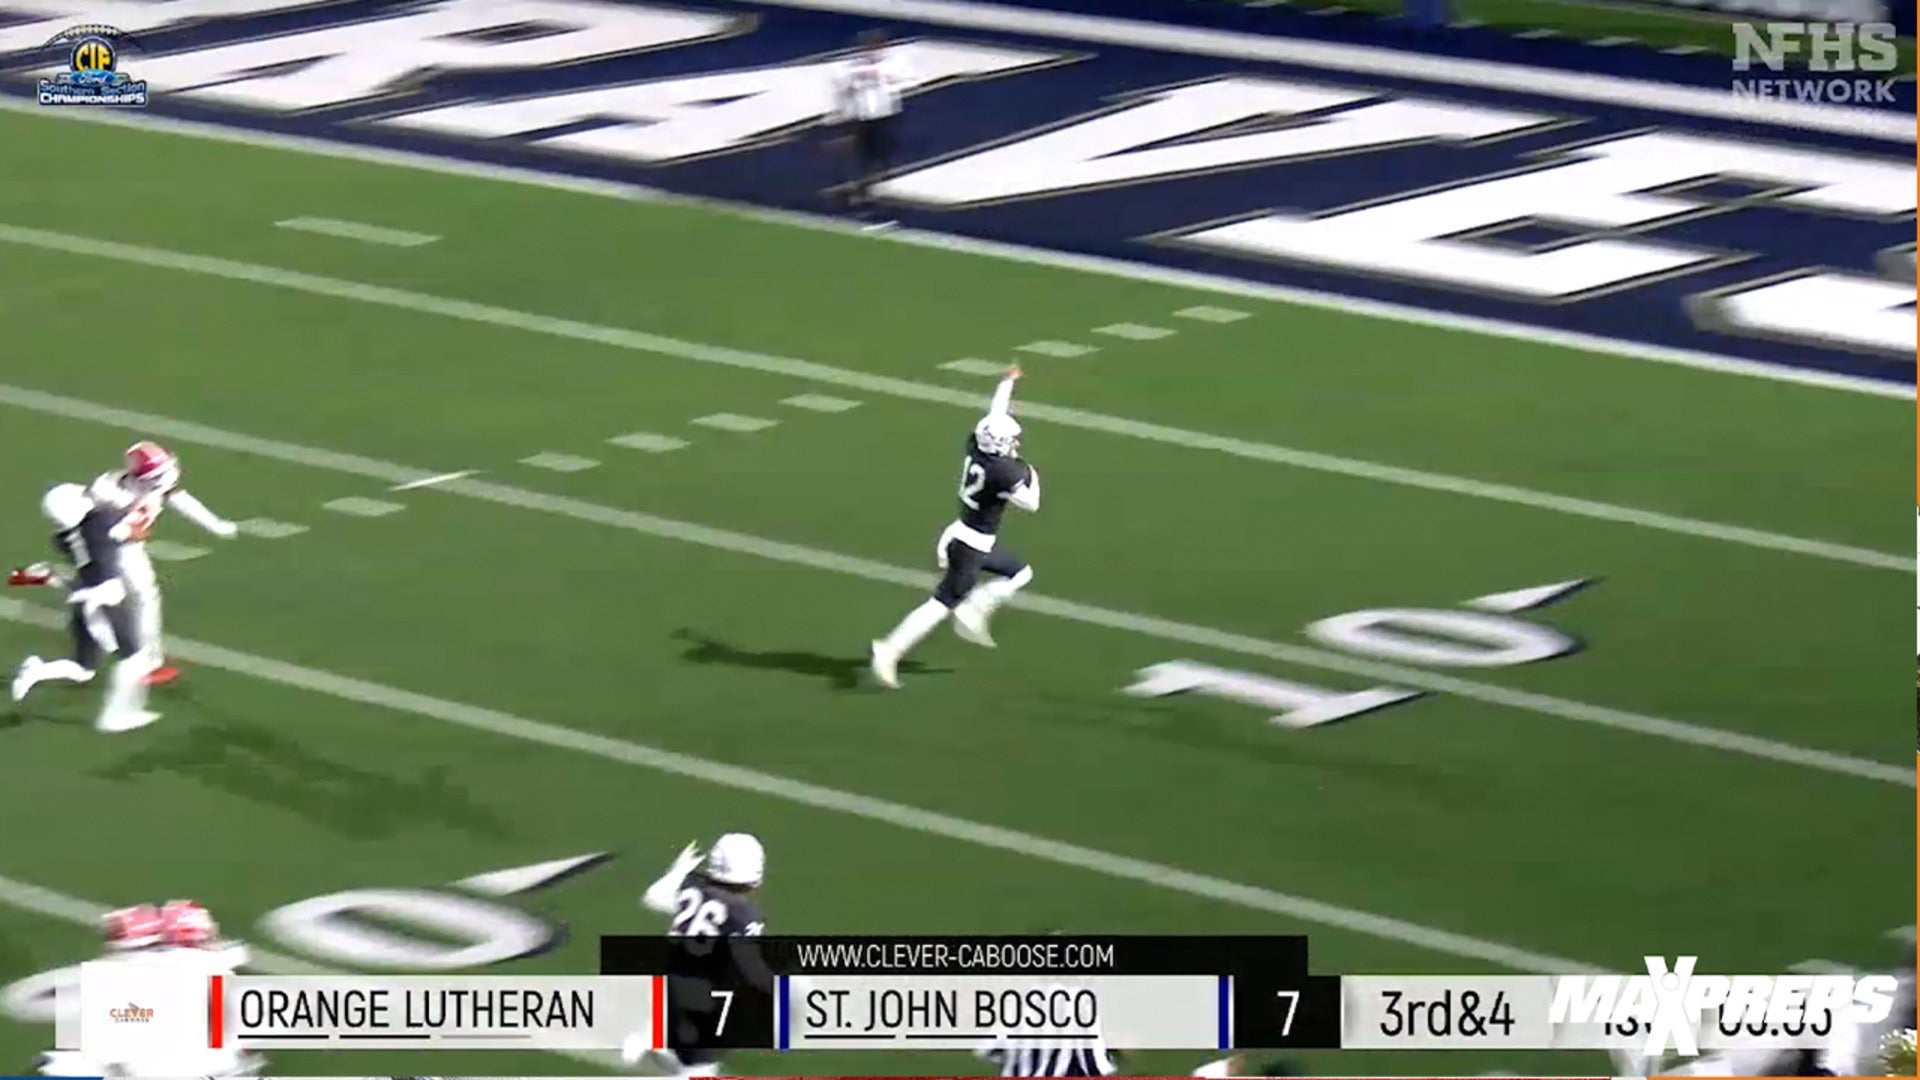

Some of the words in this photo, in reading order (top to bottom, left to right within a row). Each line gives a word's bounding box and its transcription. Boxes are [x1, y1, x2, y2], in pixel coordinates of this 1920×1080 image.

[959, 456, 986, 510] 12
[1121, 607, 1580, 728] 10
[668, 887, 728, 956] 26
